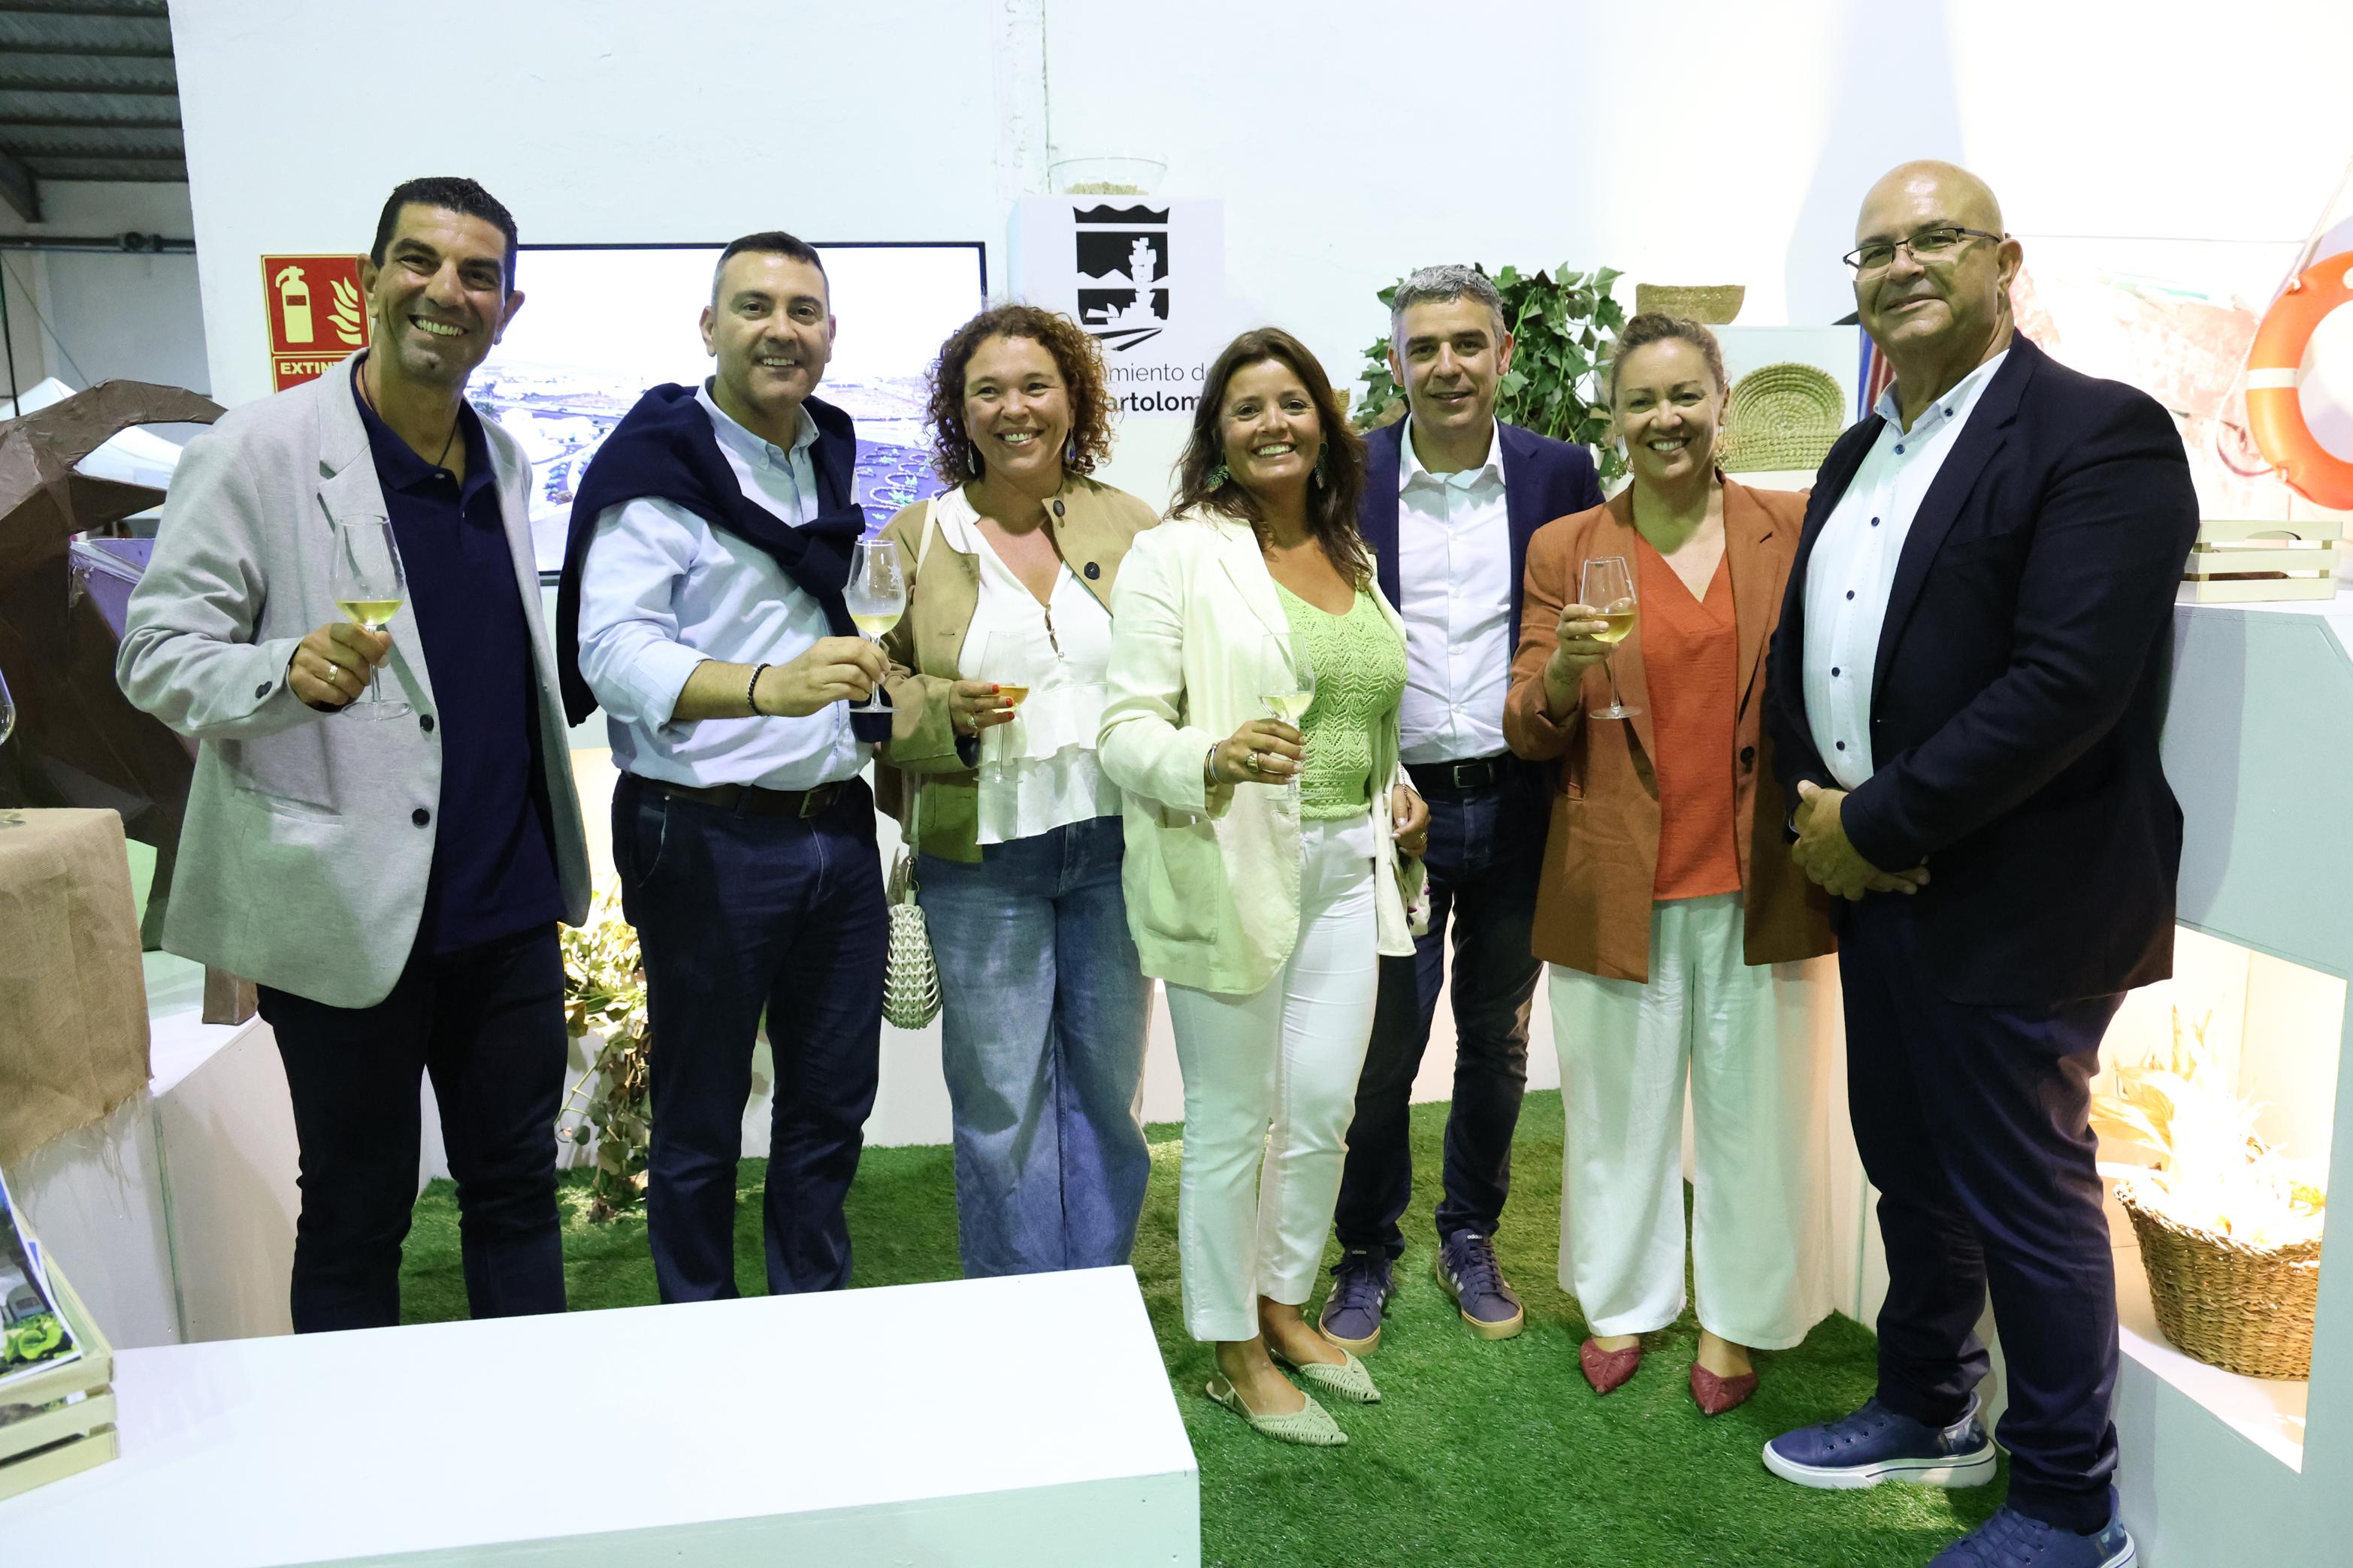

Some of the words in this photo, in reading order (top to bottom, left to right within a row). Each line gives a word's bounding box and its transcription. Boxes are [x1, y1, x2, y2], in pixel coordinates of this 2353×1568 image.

[280, 361, 341, 375] EXTIN
[1109, 362, 1184, 382] miento
[1191, 362, 1209, 381] d
